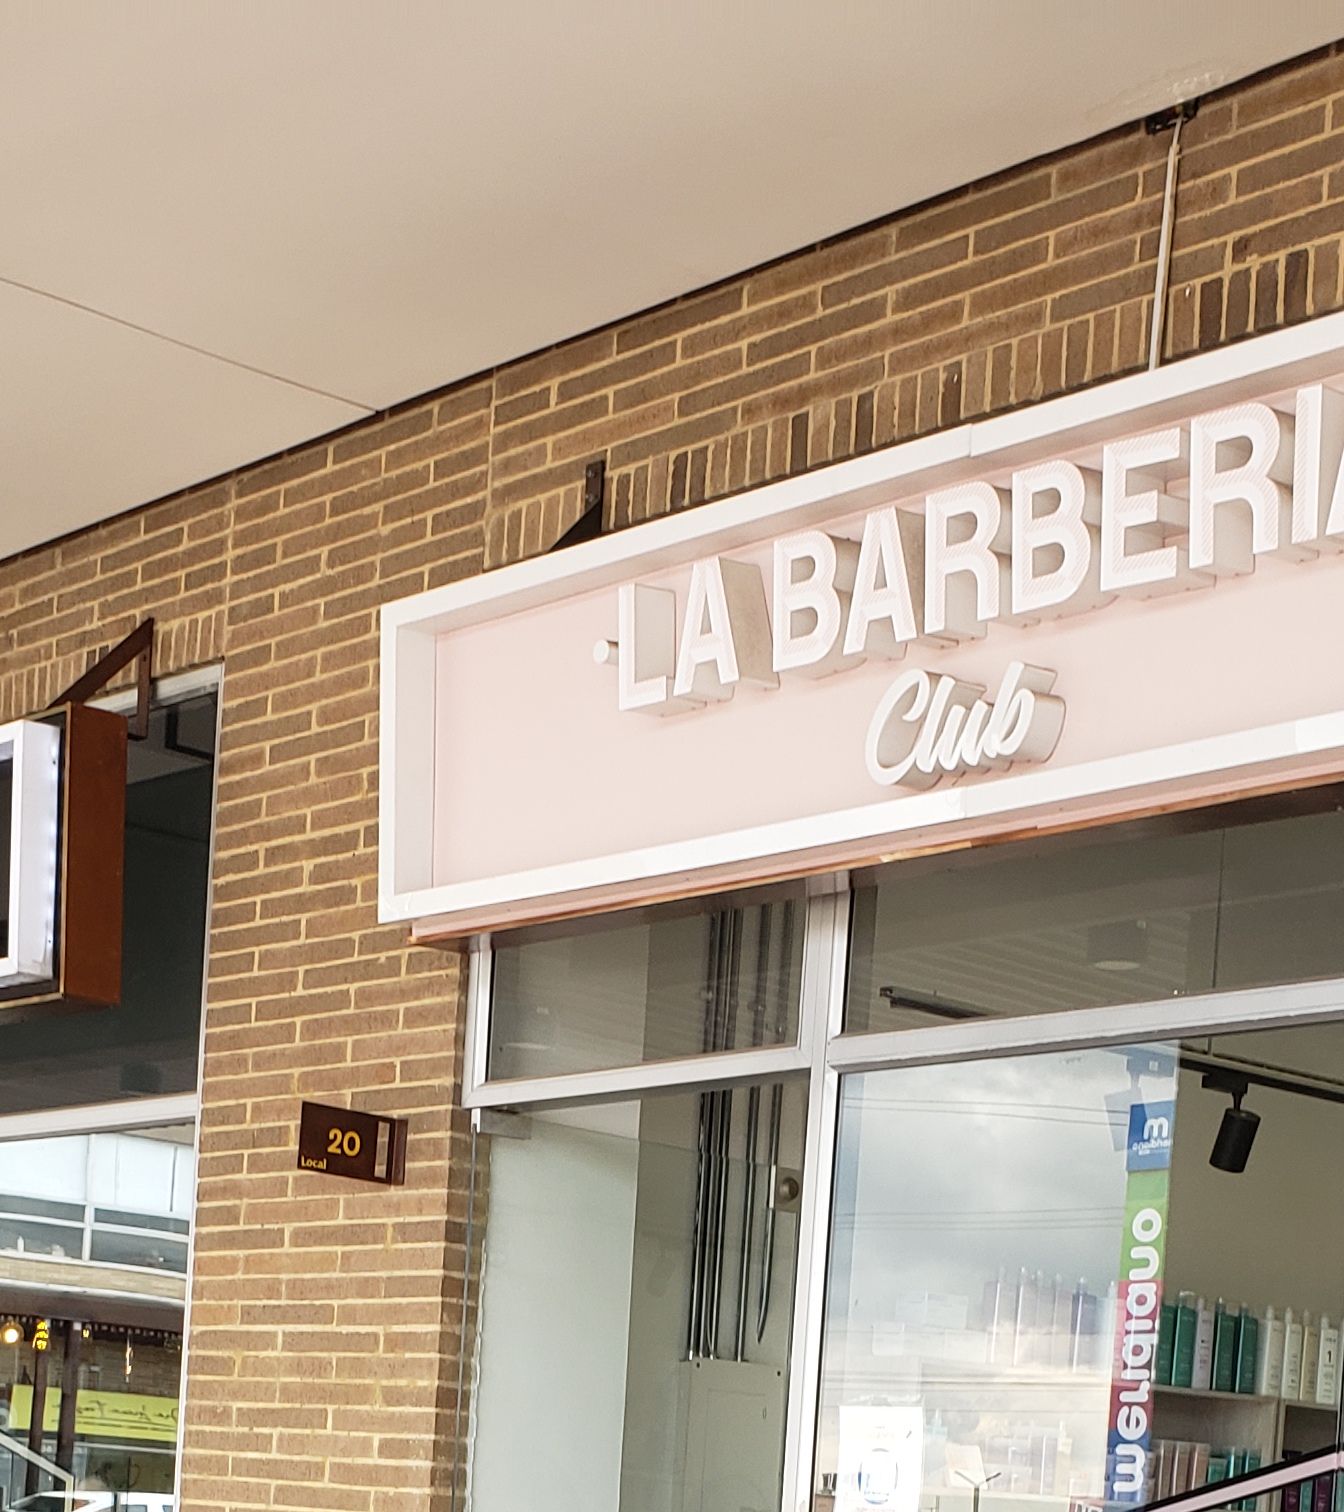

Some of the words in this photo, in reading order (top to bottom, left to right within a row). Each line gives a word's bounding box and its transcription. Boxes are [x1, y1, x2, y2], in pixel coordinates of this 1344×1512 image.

[619, 556, 739, 711] LA
[865, 660, 1036, 786] Club
[301, 1155, 327, 1171] Local
[327, 1127, 361, 1157] 20
